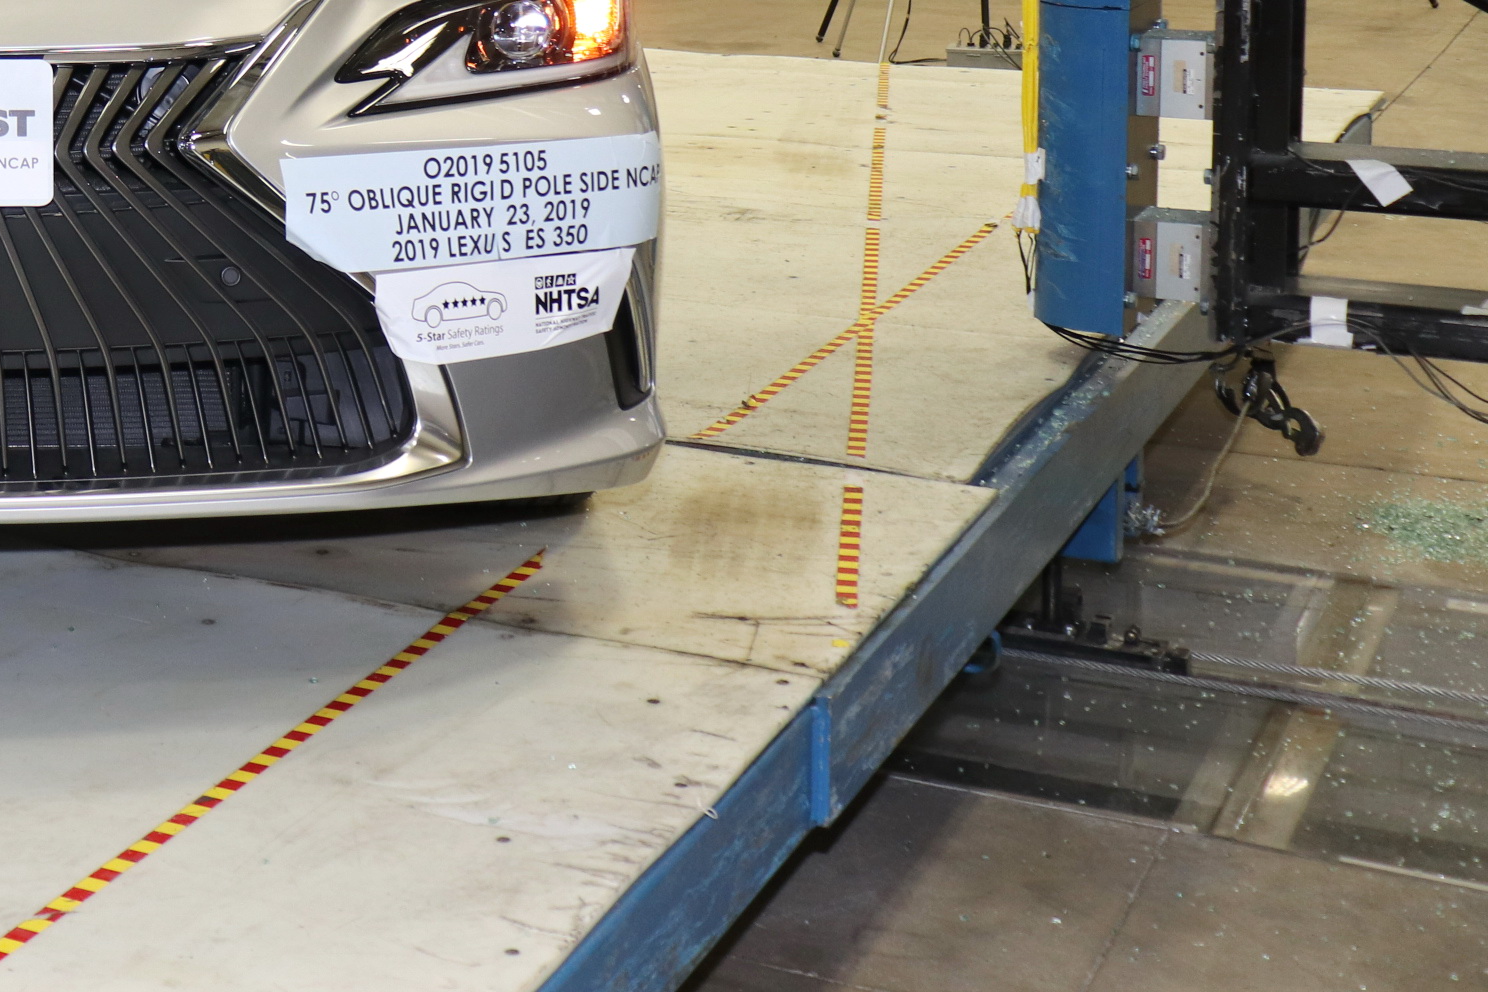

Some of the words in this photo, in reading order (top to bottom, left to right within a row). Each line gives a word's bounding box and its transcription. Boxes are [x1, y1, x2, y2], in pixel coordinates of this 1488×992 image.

[347, 183, 443, 212] OBLIQUE
[522, 175, 573, 199] POLE
[579, 168, 620, 194] SIDE
[395, 206, 496, 236] JANUARY
[505, 203, 536, 227] 23,
[543, 198, 591, 222] 2019
[392, 238, 440, 263] 2019
[524, 227, 546, 250] ES
[552, 224, 589, 248] 350
[534, 286, 600, 316] NHTSA
[416, 330, 446, 343] 5-Star
[447, 327, 473, 342] Safety
[474, 323, 504, 339] Ratings
